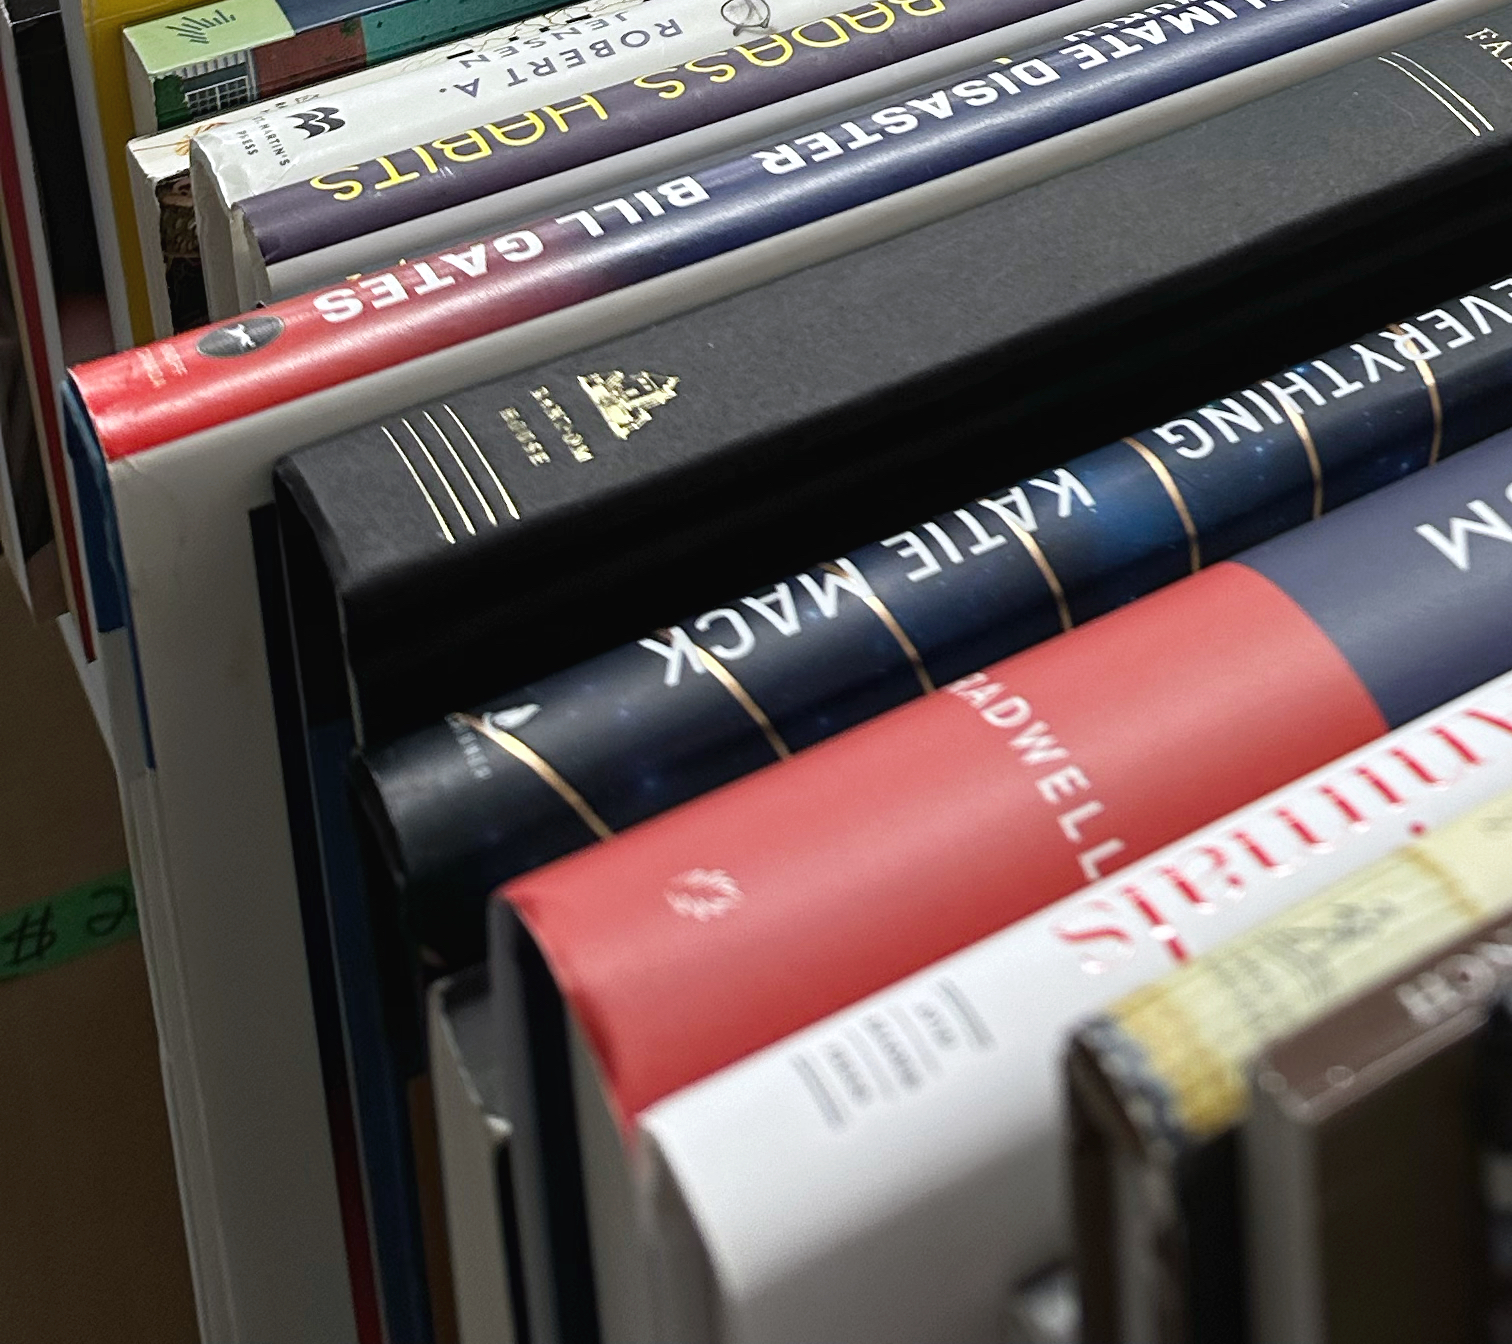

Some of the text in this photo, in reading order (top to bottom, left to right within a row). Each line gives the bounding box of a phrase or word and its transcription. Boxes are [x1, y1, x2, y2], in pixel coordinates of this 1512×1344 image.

[501, 18, 684, 87] ROBERT
[309, 93, 613, 203] HABITS
[753, 52, 1066, 179] DISASTER
[556, 175, 712, 239] BILL
[312, 229, 545, 324] GATES
[880, 467, 1098, 585] KATIE
[641, 557, 877, 690] MACK
